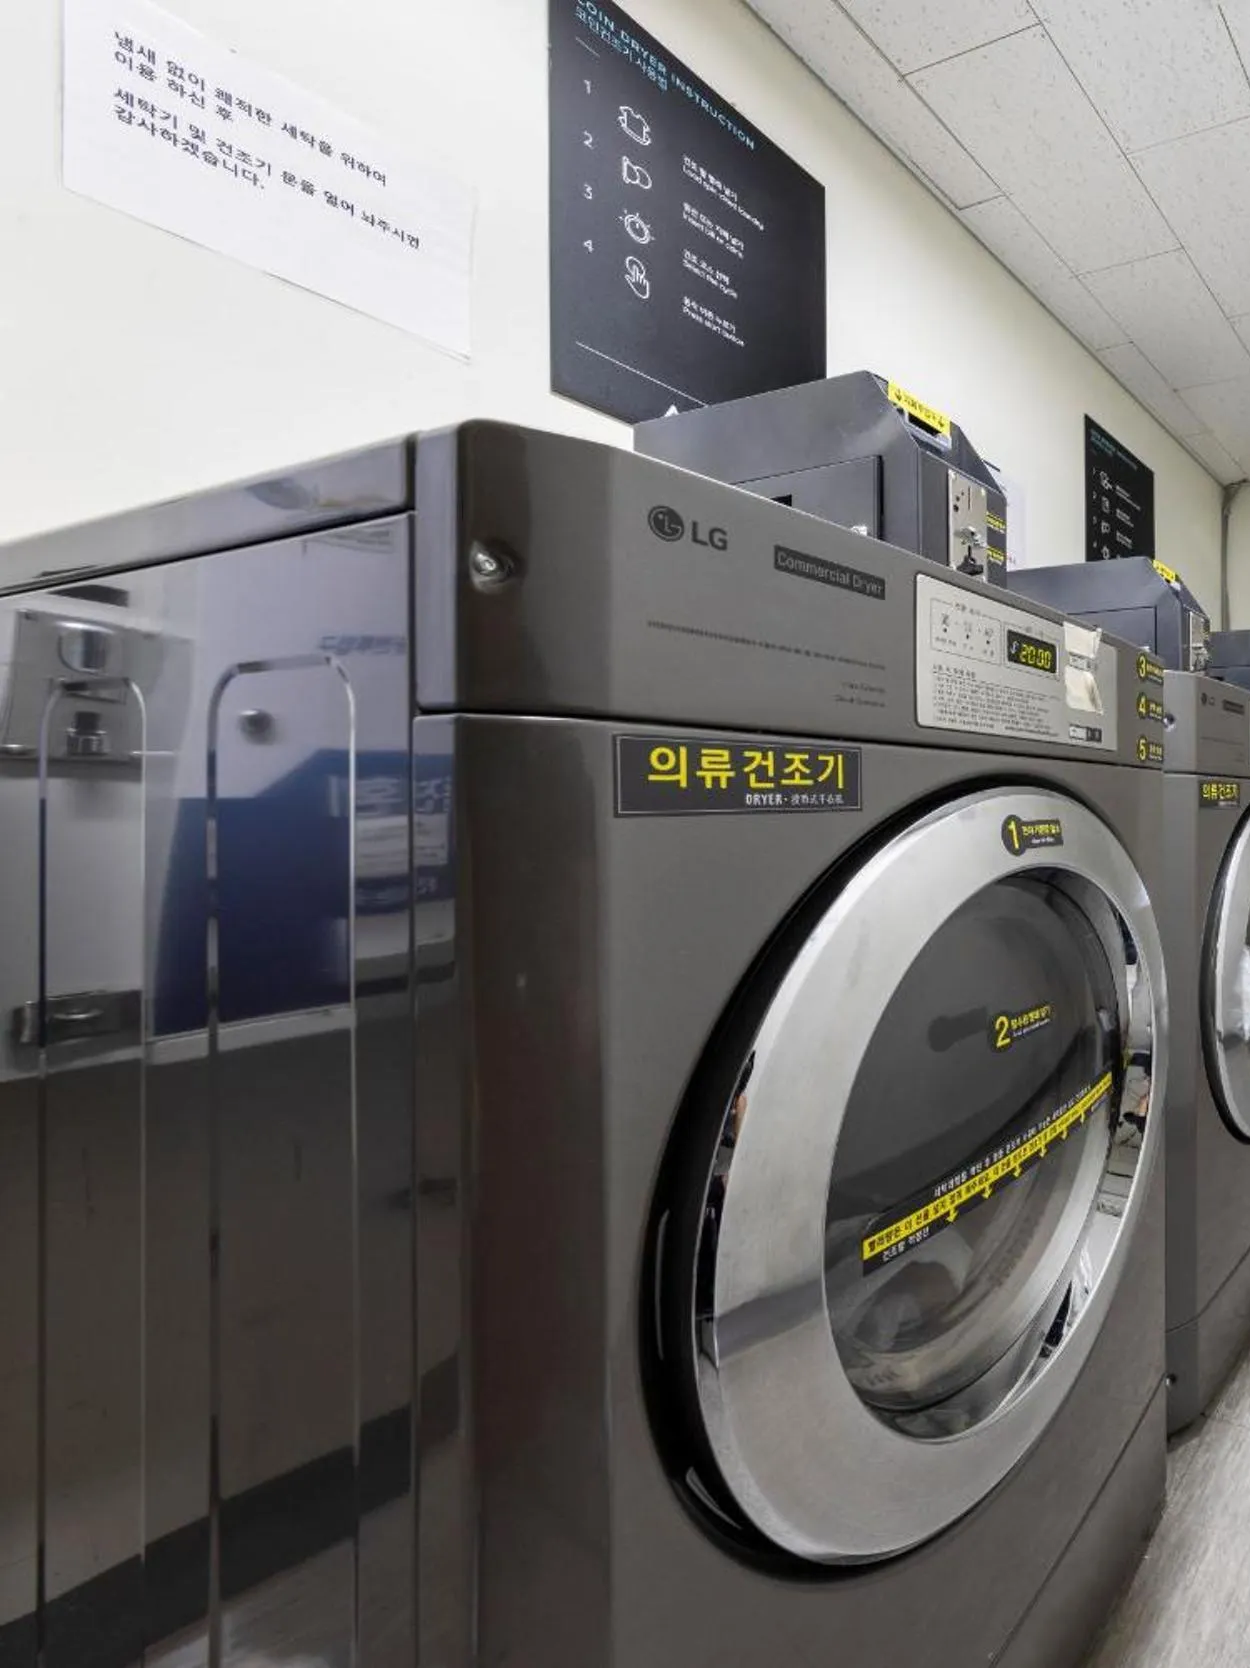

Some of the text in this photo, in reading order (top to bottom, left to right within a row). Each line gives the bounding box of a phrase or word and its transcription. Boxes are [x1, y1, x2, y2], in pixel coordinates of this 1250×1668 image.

[114, 51, 233, 122] 이용 하신 후
[584, 79, 592, 95] 1
[621, 30, 667, 75] DRYER
[671, 72, 754, 150] INSTRUCTION
[114, 31, 386, 187] 냄새 없이 쾌적한 세탁을 위하여
[114, 104, 265, 189] 감사하겠습니다.
[114, 87, 178, 129] 세탁기
[189, 124, 206, 144] 및
[216, 138, 271, 176] 건조기
[323, 190, 354, 217] 열어
[584, 131, 593, 148] 2
[584, 184, 593, 200] 3
[583, 239, 593, 253] 4
[692, 520, 728, 551] LG
[777, 551, 883, 595] Commercial Dryer
[648, 746, 844, 789] 의류건조기
[1007, 820, 1020, 849] 1
[995, 1015, 1011, 1049] 2
